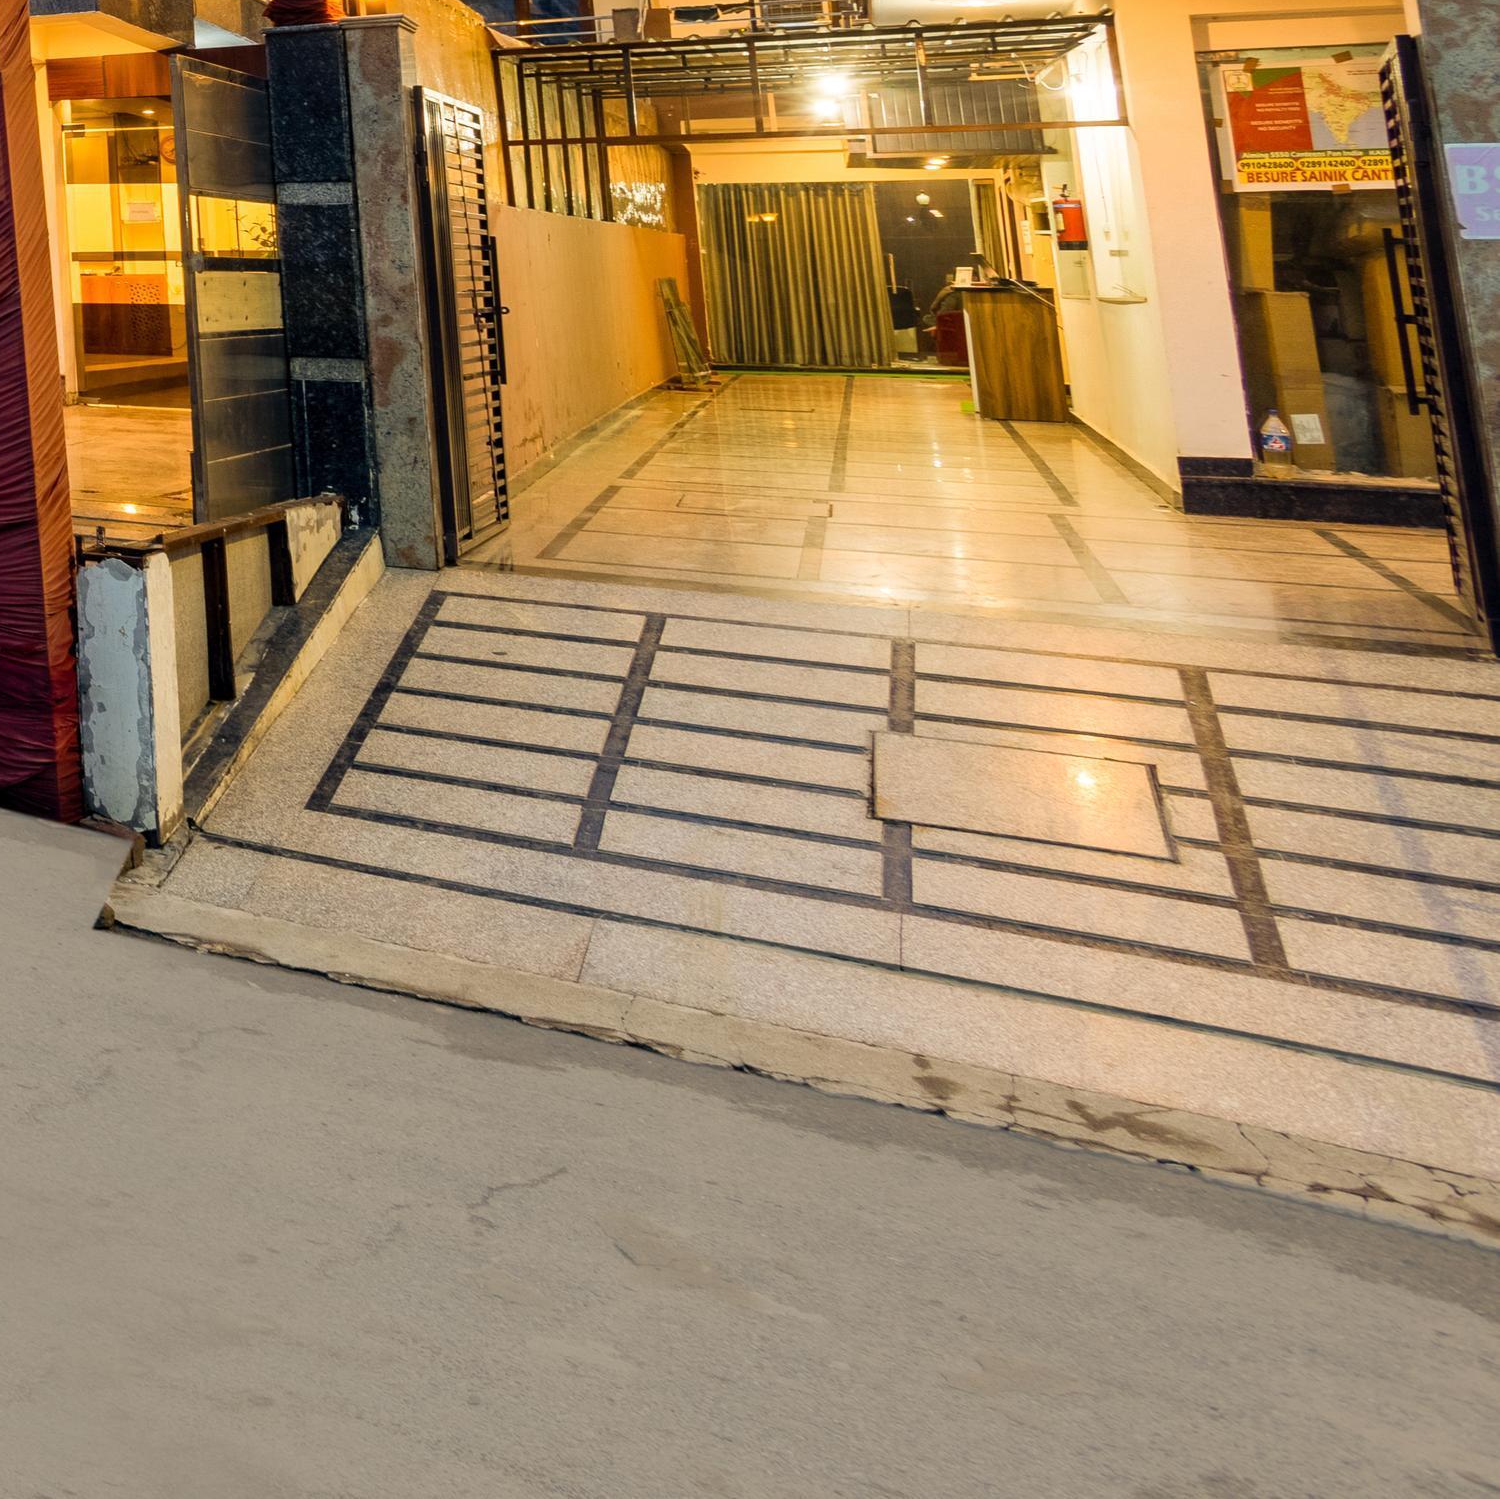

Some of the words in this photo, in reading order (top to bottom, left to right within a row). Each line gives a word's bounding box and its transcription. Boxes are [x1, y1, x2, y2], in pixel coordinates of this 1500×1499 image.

[1361, 158, 1391, 167] 92891
[1246, 170, 1298, 183] BESURE
[1301, 169, 1348, 183] SAINIK
[1352, 169, 1391, 182] CANT
